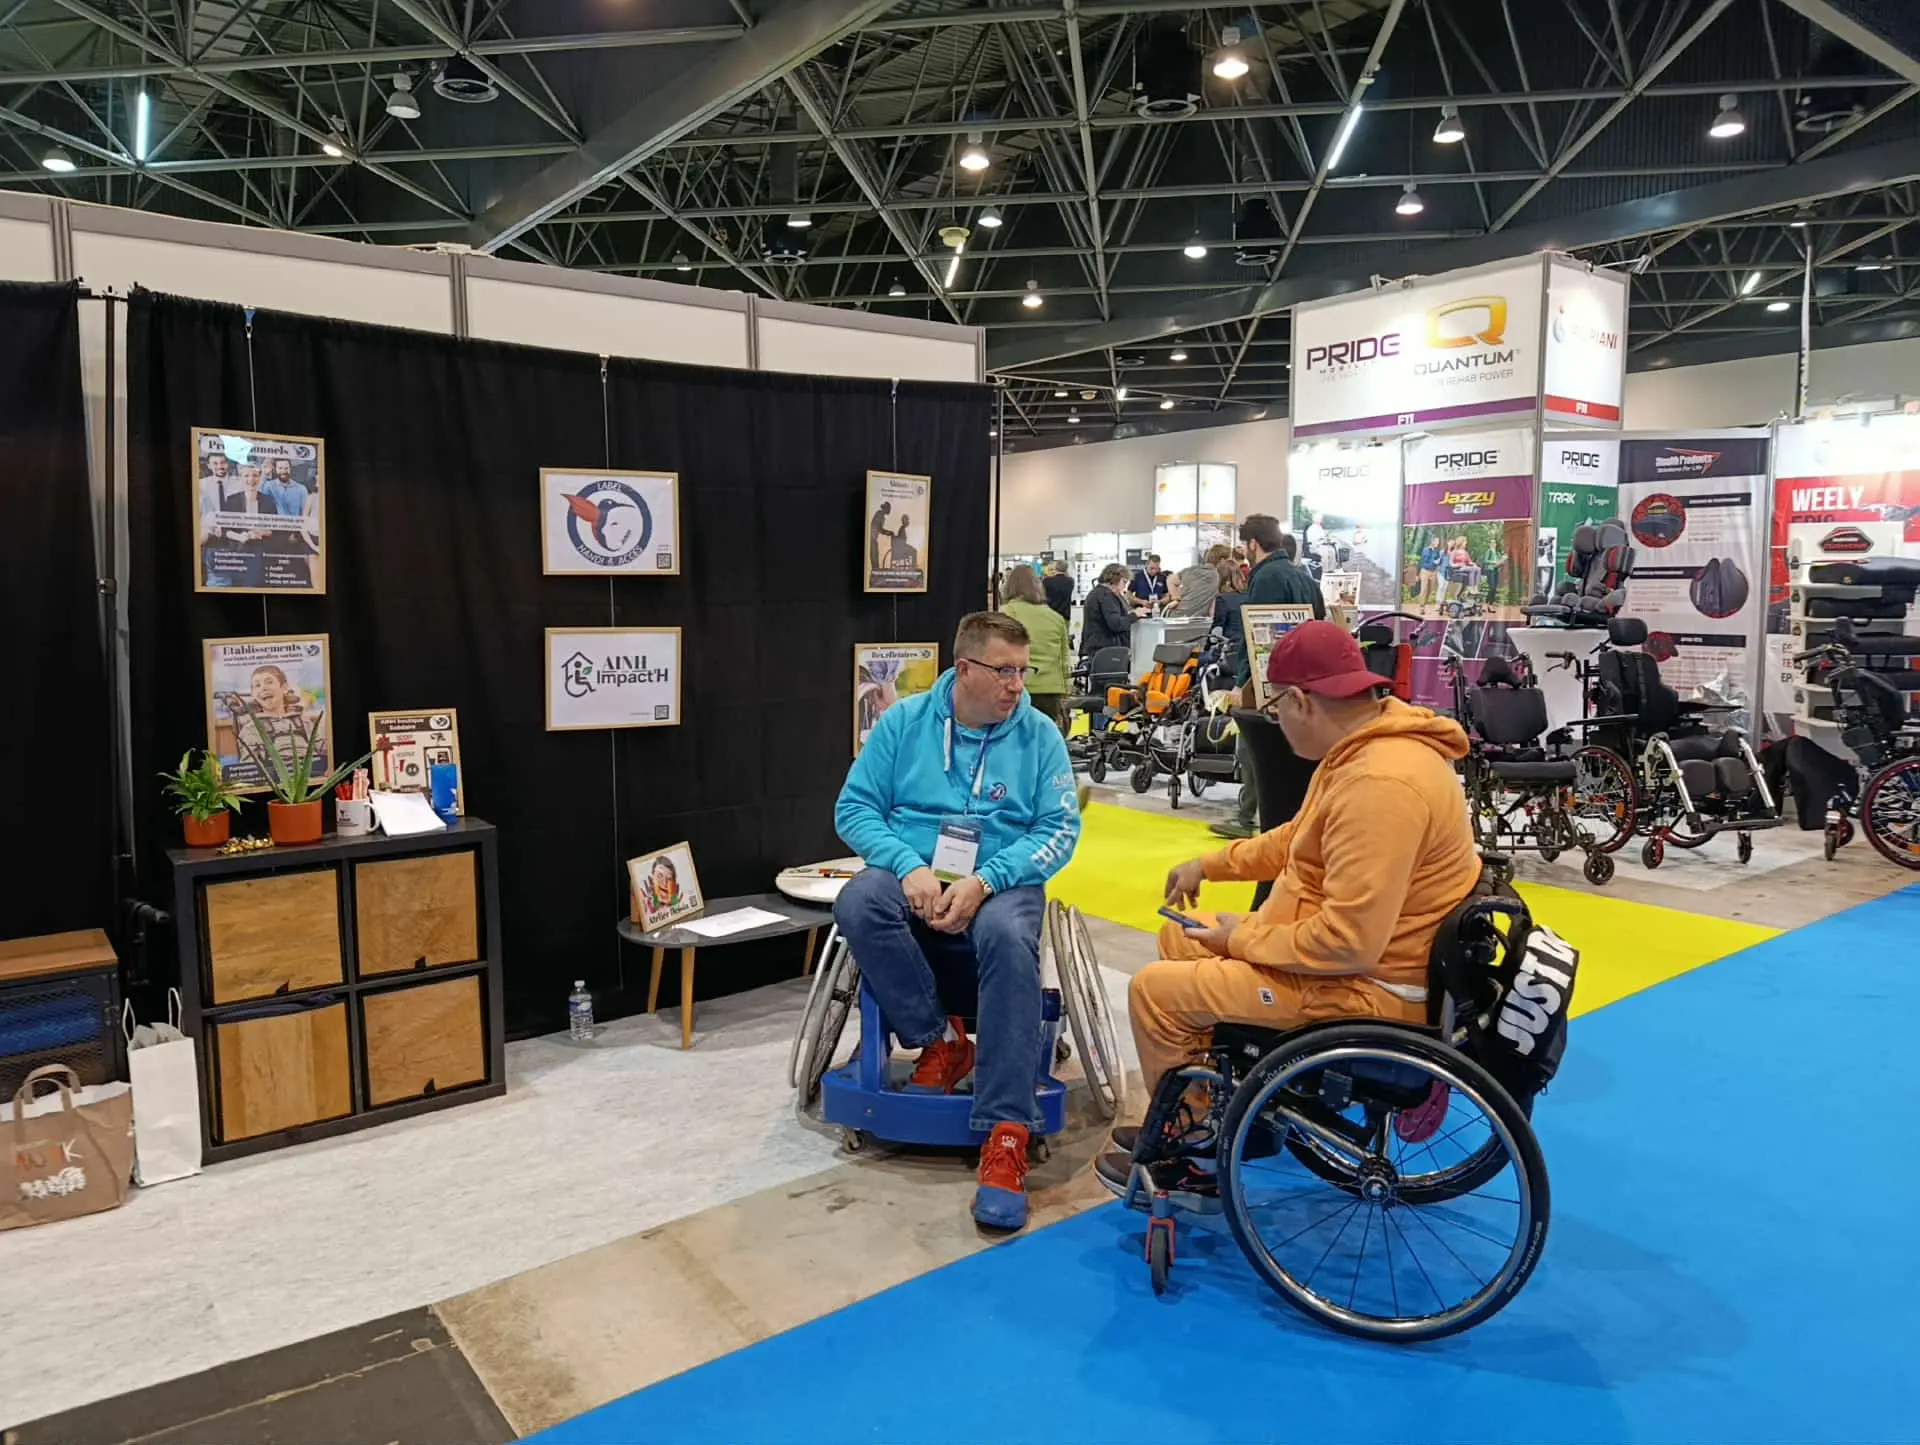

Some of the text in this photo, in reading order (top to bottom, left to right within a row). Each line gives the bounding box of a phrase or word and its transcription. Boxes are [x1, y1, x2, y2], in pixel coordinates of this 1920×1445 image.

[1306, 333, 1400, 370] PRIDE
[1414, 349, 1513, 376] QUANTUM
[1479, 369, 1513, 382] POWER
[1435, 450, 1497, 469] PRIDE
[1561, 450, 1600, 468] PRIDE
[1319, 464, 1371, 481] PRIDE
[1548, 491, 1576, 505] TRAK
[1791, 485, 1862, 512] WEELY
[597, 667, 669, 688] Impact'H
[1497, 948, 1573, 1056] JUST
